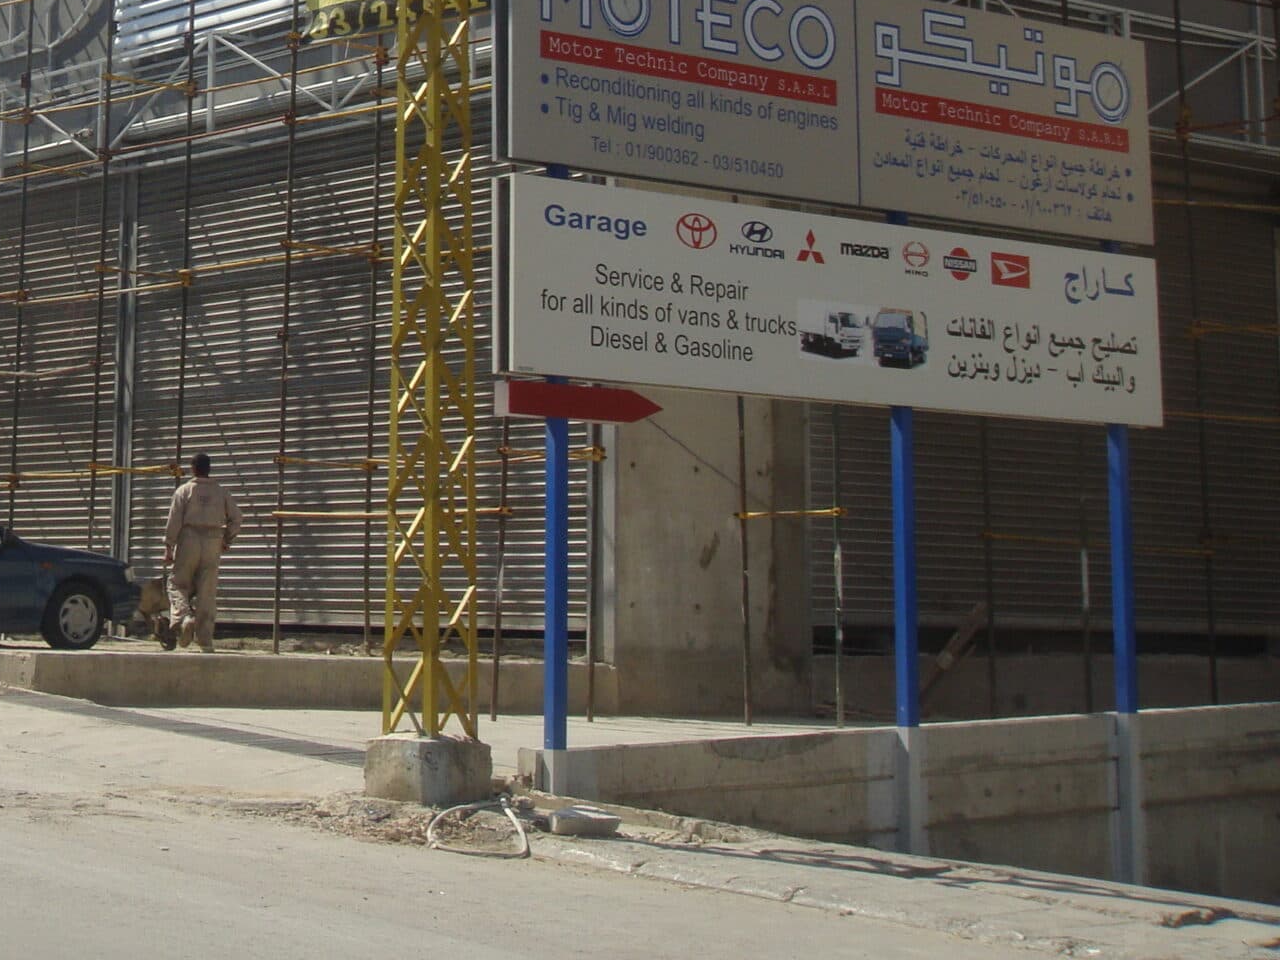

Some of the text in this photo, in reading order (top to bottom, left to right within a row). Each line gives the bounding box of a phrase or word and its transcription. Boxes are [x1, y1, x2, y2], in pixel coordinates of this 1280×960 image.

[548, 37, 604, 60] Motor
[616, 49, 688, 75] Technic
[698, 63, 769, 91] Company
[874, 8, 1130, 124] موتيكو
[554, 97, 705, 141] Tig & Mig welding
[556, 68, 838, 131] Reconditioning all kinds of engines
[881, 94, 928, 114] Motor
[939, 103, 1001, 127] Technic
[1009, 116, 1070, 140] Company
[592, 136, 611, 153] Tel
[625, 142, 698, 166] 01/900362
[713, 155, 783, 179] 03/510450
[544, 204, 648, 240] Garage
[729, 243, 785, 260] HYUNDAI
[595, 263, 749, 302] Service & Repair
[541, 289, 797, 336] for all kinds of vans & trucks
[590, 326, 754, 362] Diesel & Gasoline
[1003, 324, 1040, 353] انواع
[1049, 332, 1086, 356] جميع
[1092, 334, 1137, 361] تصليح
[1007, 357, 1040, 382] ديزل
